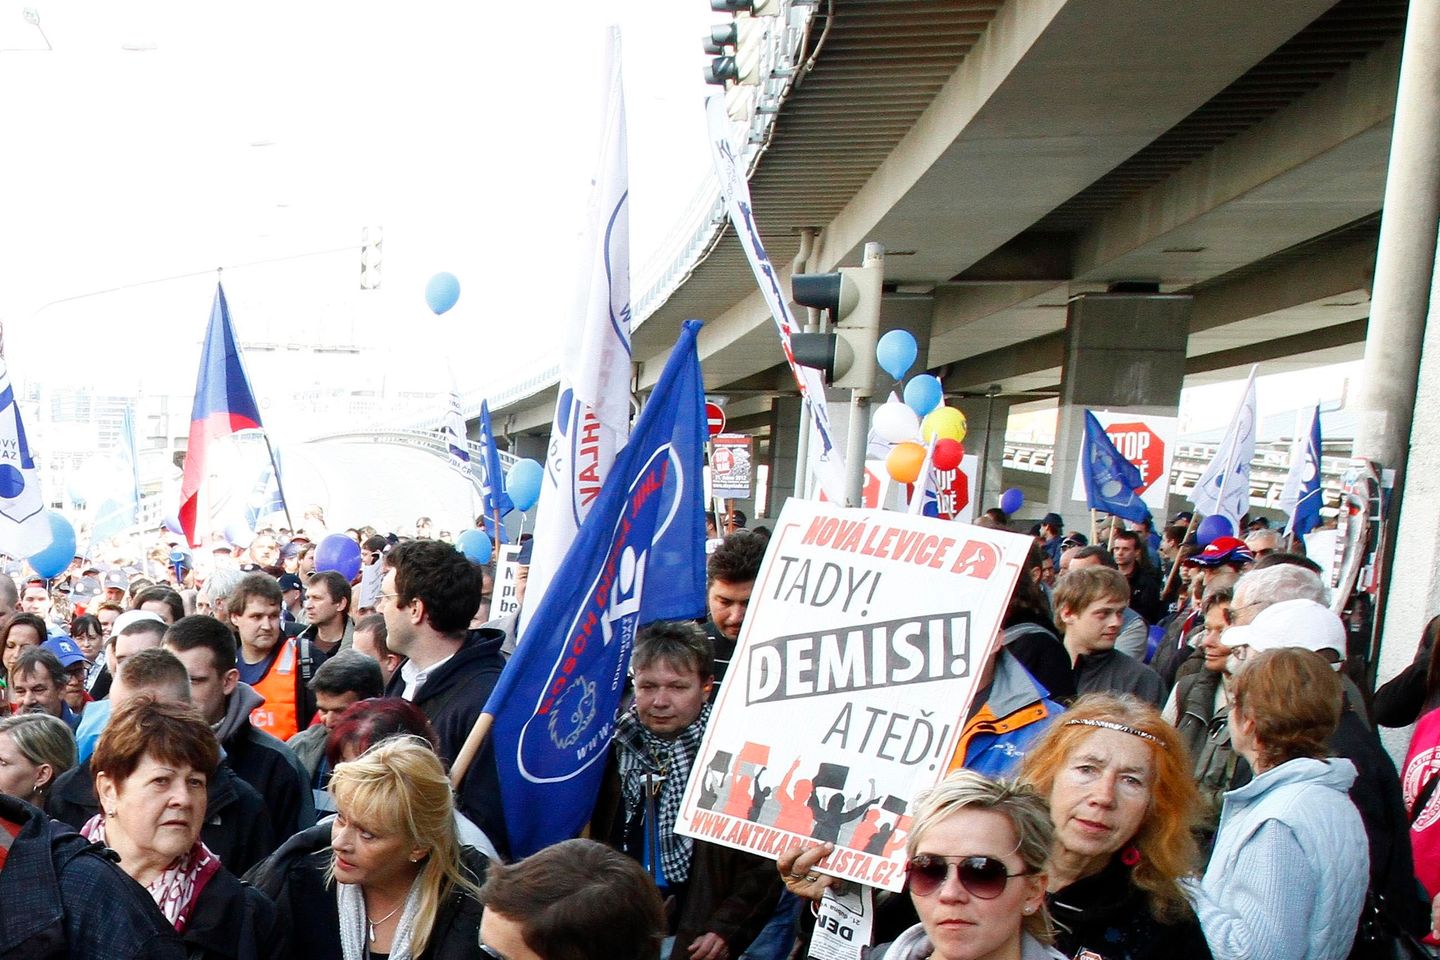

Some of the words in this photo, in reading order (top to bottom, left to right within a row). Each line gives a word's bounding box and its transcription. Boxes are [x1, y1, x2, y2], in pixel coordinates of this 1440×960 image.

[800, 516, 869, 553] NOVÁ
[860, 525, 956, 569] LEVICE
[773, 556, 883, 617] TADY!
[748, 615, 970, 704] DEMISI!
[822, 702, 854, 749] A
[858, 707, 951, 771] TEĎ!
[689, 810, 899, 886] WWW.ANTIKAPLISTA.CZ
